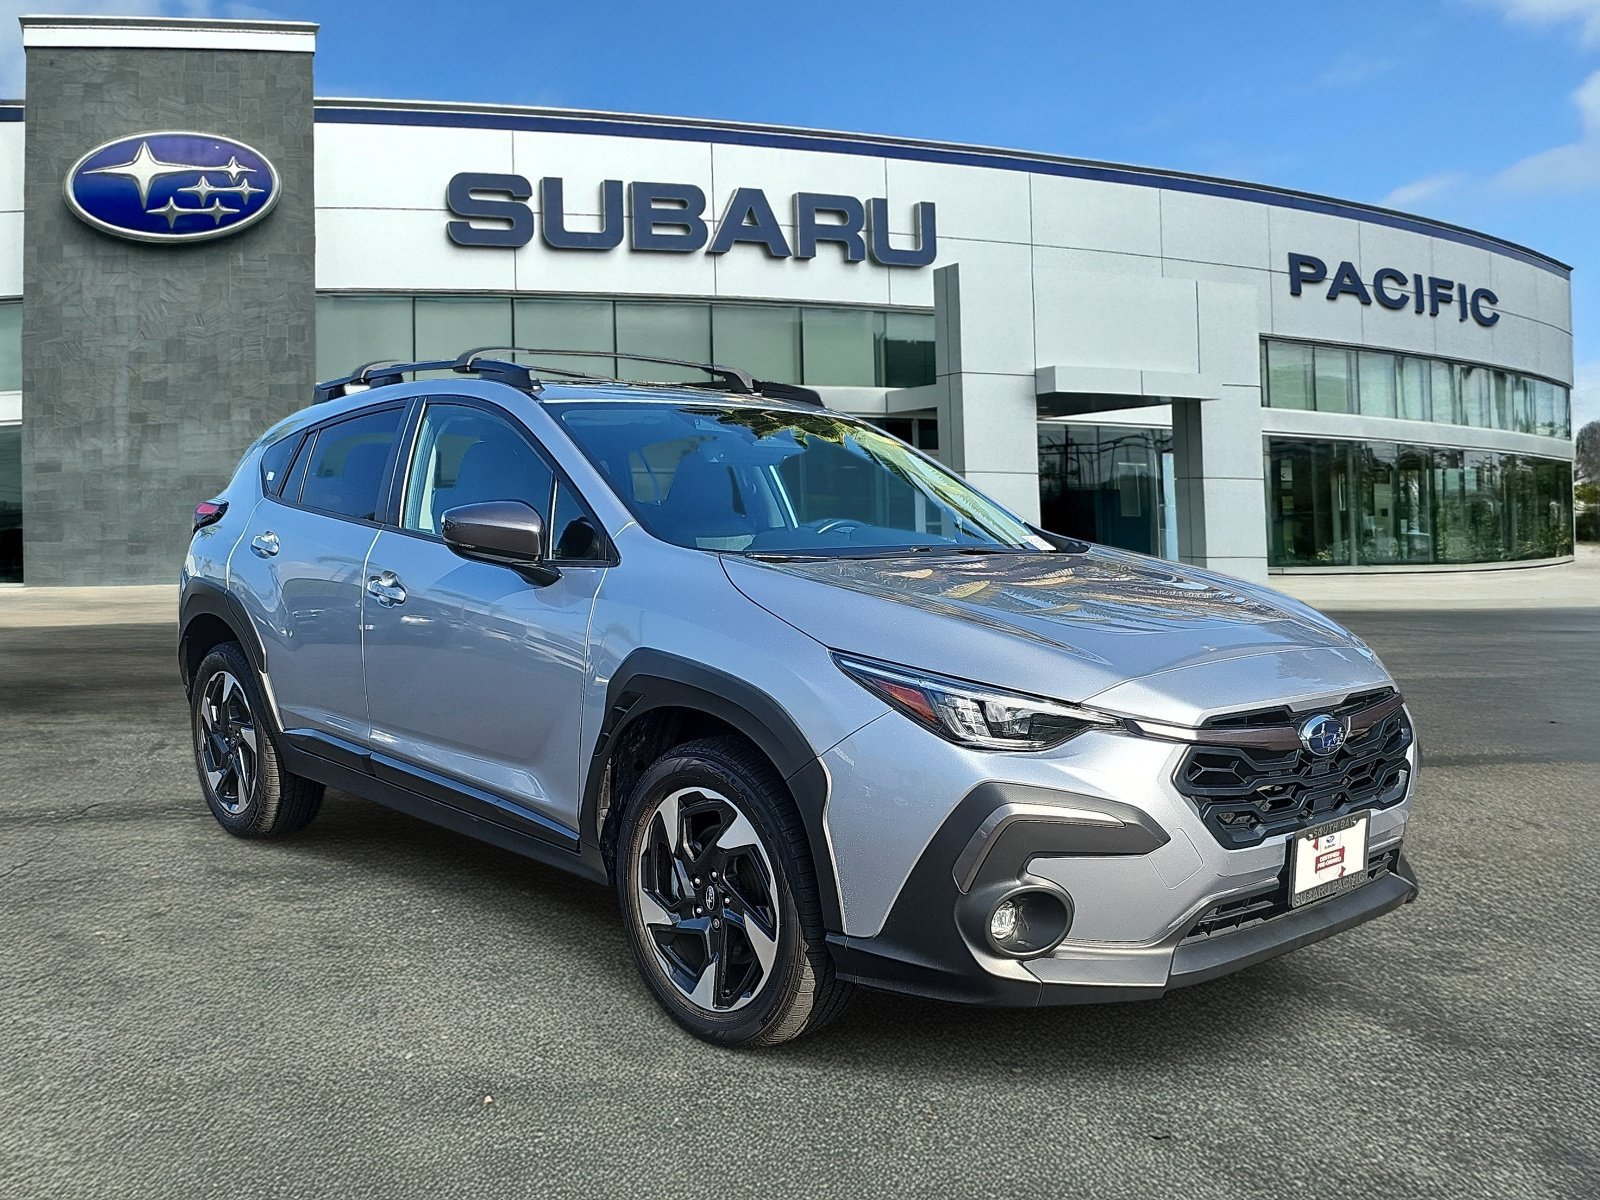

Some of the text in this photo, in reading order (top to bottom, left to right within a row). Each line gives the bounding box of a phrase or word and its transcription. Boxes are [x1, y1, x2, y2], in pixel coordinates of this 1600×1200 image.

[447, 171, 937, 267] SUBARU
[1287, 252, 1500, 327] PACIFIC
[1313, 816, 1356, 838] SOUTH BAY
[1295, 885, 1331, 906] SUBARU
